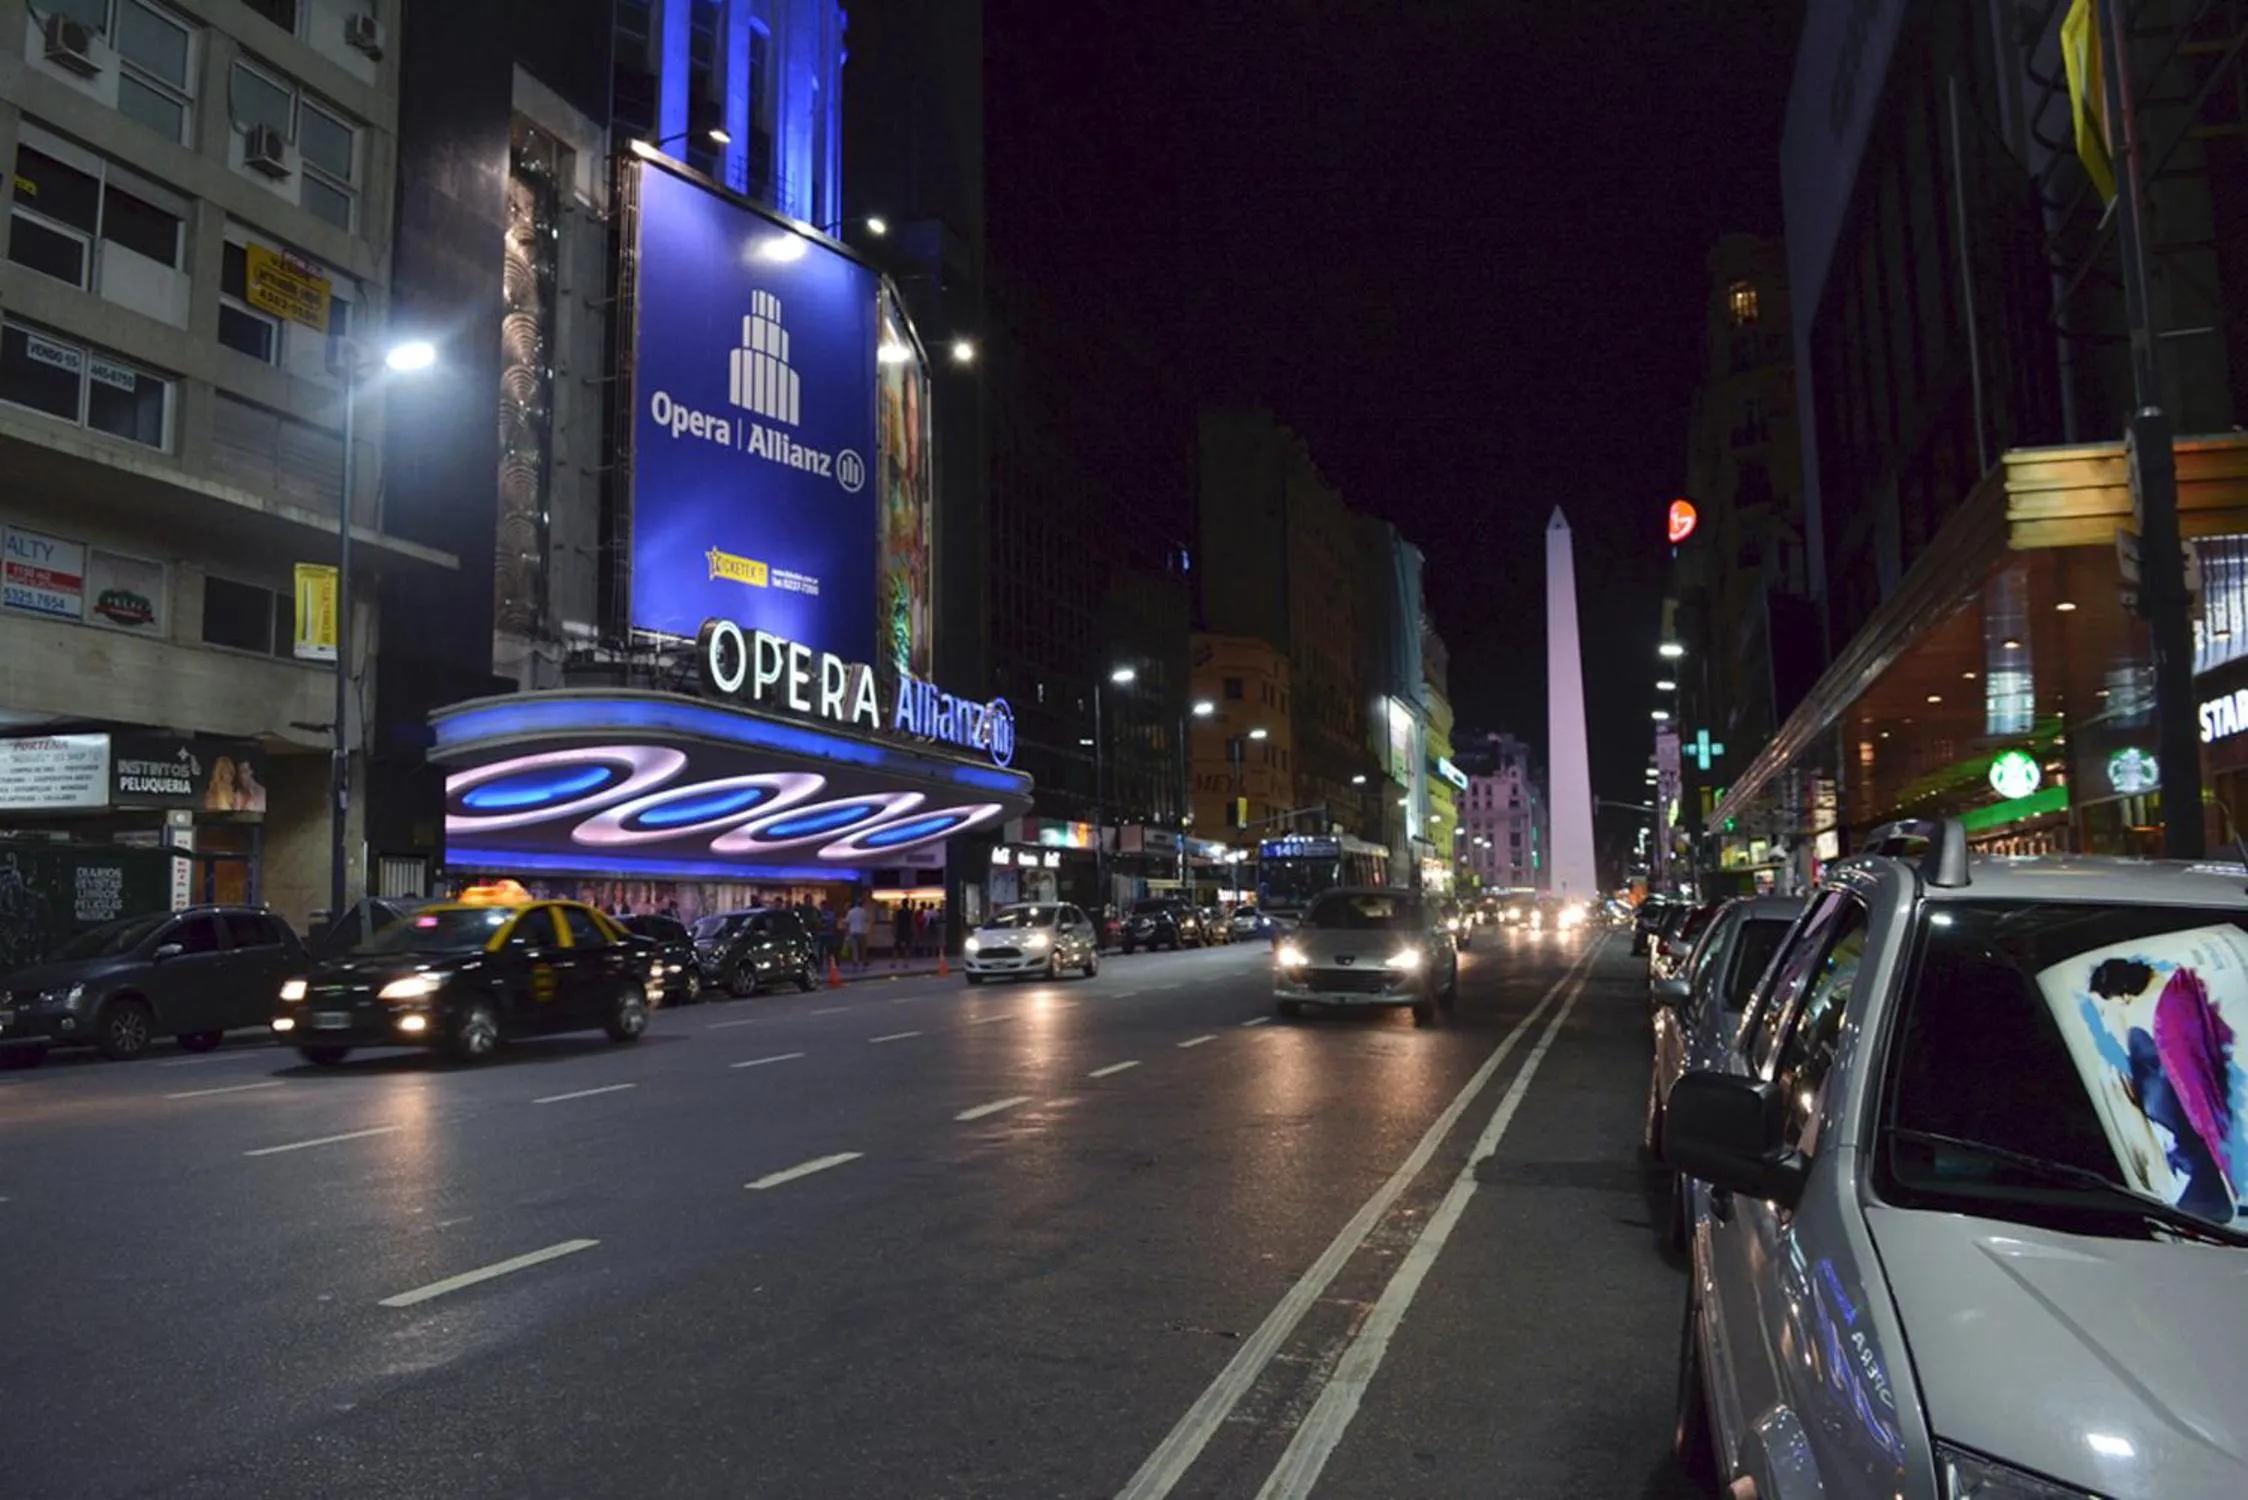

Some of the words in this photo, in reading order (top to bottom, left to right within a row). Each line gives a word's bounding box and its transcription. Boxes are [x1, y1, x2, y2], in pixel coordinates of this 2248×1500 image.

[651, 391, 731, 446] Opera
[748, 423, 832, 478] Allianz
[709, 620, 880, 730] OPERA
[895, 673, 987, 751] Allianz
[120, 776, 192, 794] PELUQUERIA
